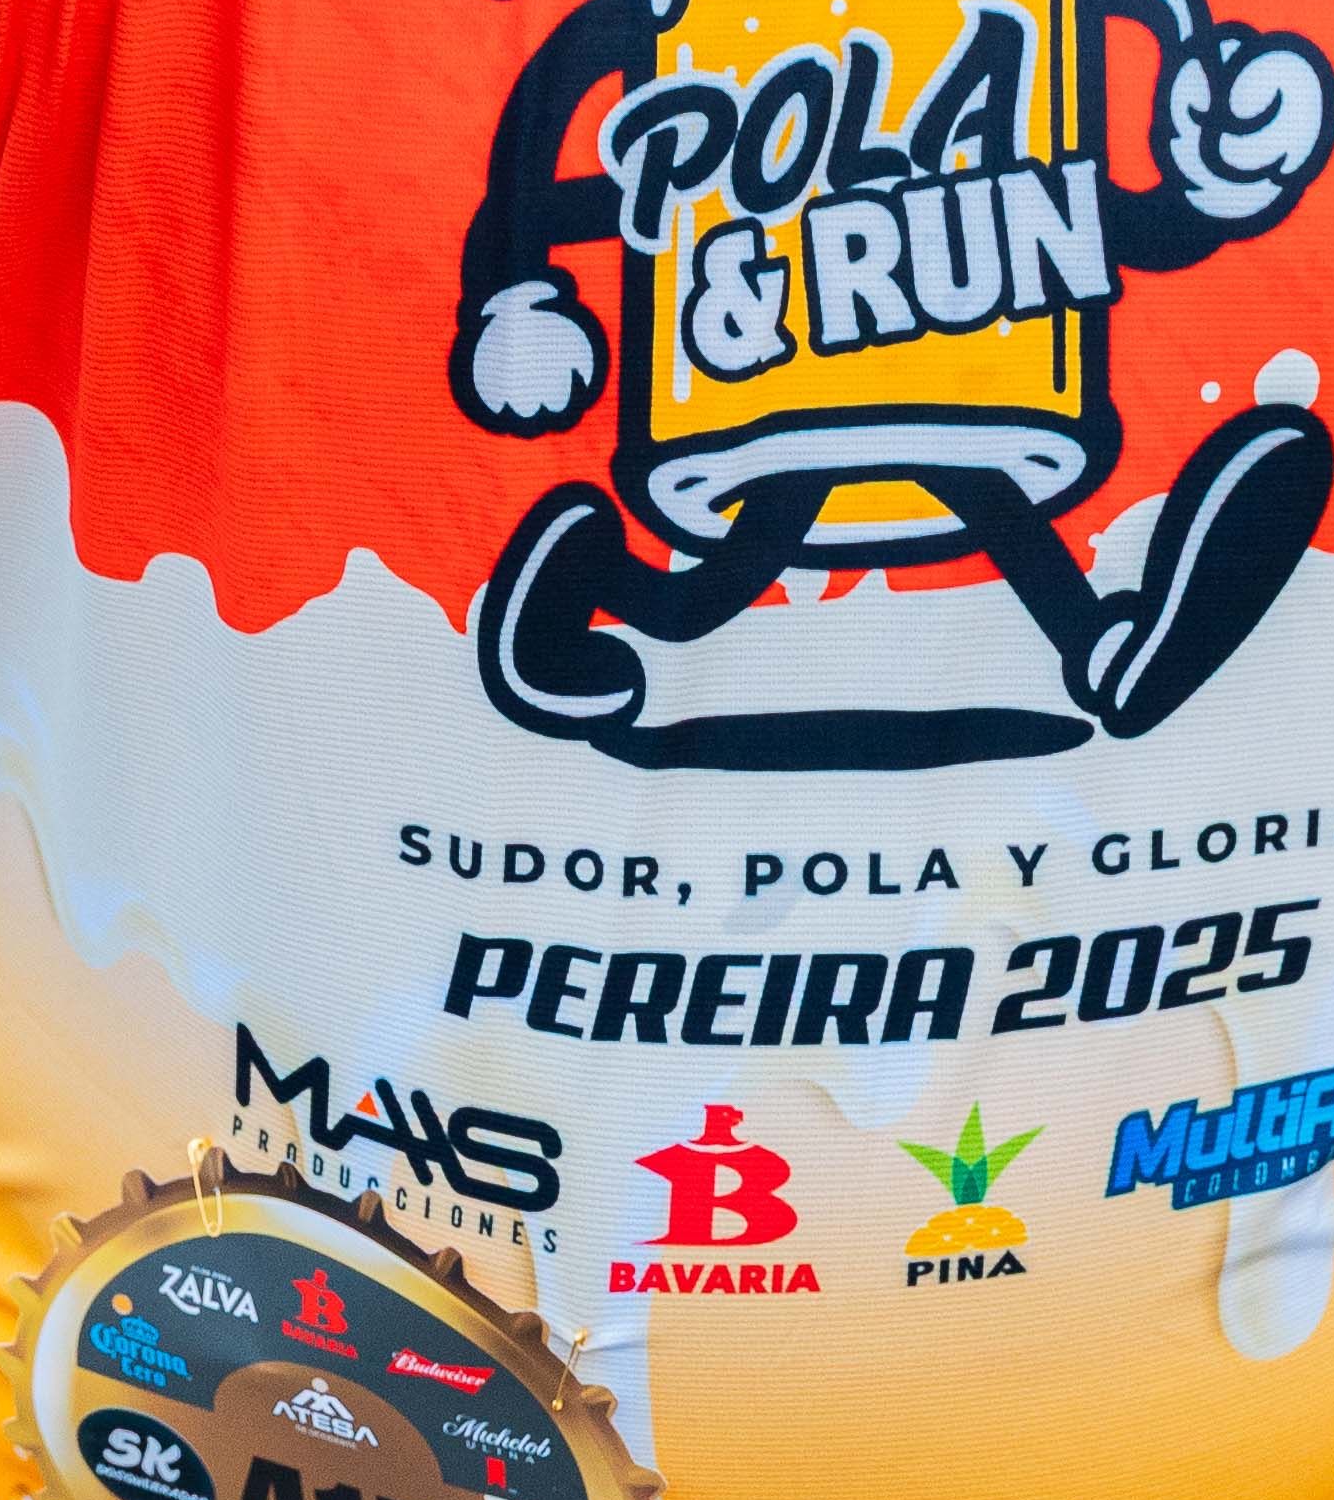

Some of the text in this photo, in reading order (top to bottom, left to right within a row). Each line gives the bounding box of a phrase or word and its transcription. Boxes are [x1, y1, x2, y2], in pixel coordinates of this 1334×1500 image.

[605, 3, 1031, 246] POLA
[687, 162, 1113, 376] & RUN
[399, 825, 692, 905] SUDOR,
[745, 852, 960, 897] POLA
[1007, 843, 1048, 887] Y
[443, 899, 1320, 1046] PEREIRA 2025
[157, 1263, 260, 1324] ZALVA
[609, 1262, 821, 1294] BAVARIA
[906, 1250, 1027, 1287] PINA
[89, 1321, 189, 1379] Corona
[391, 1351, 487, 1388] Budweiser
[441, 1413, 552, 1458] Michelob
